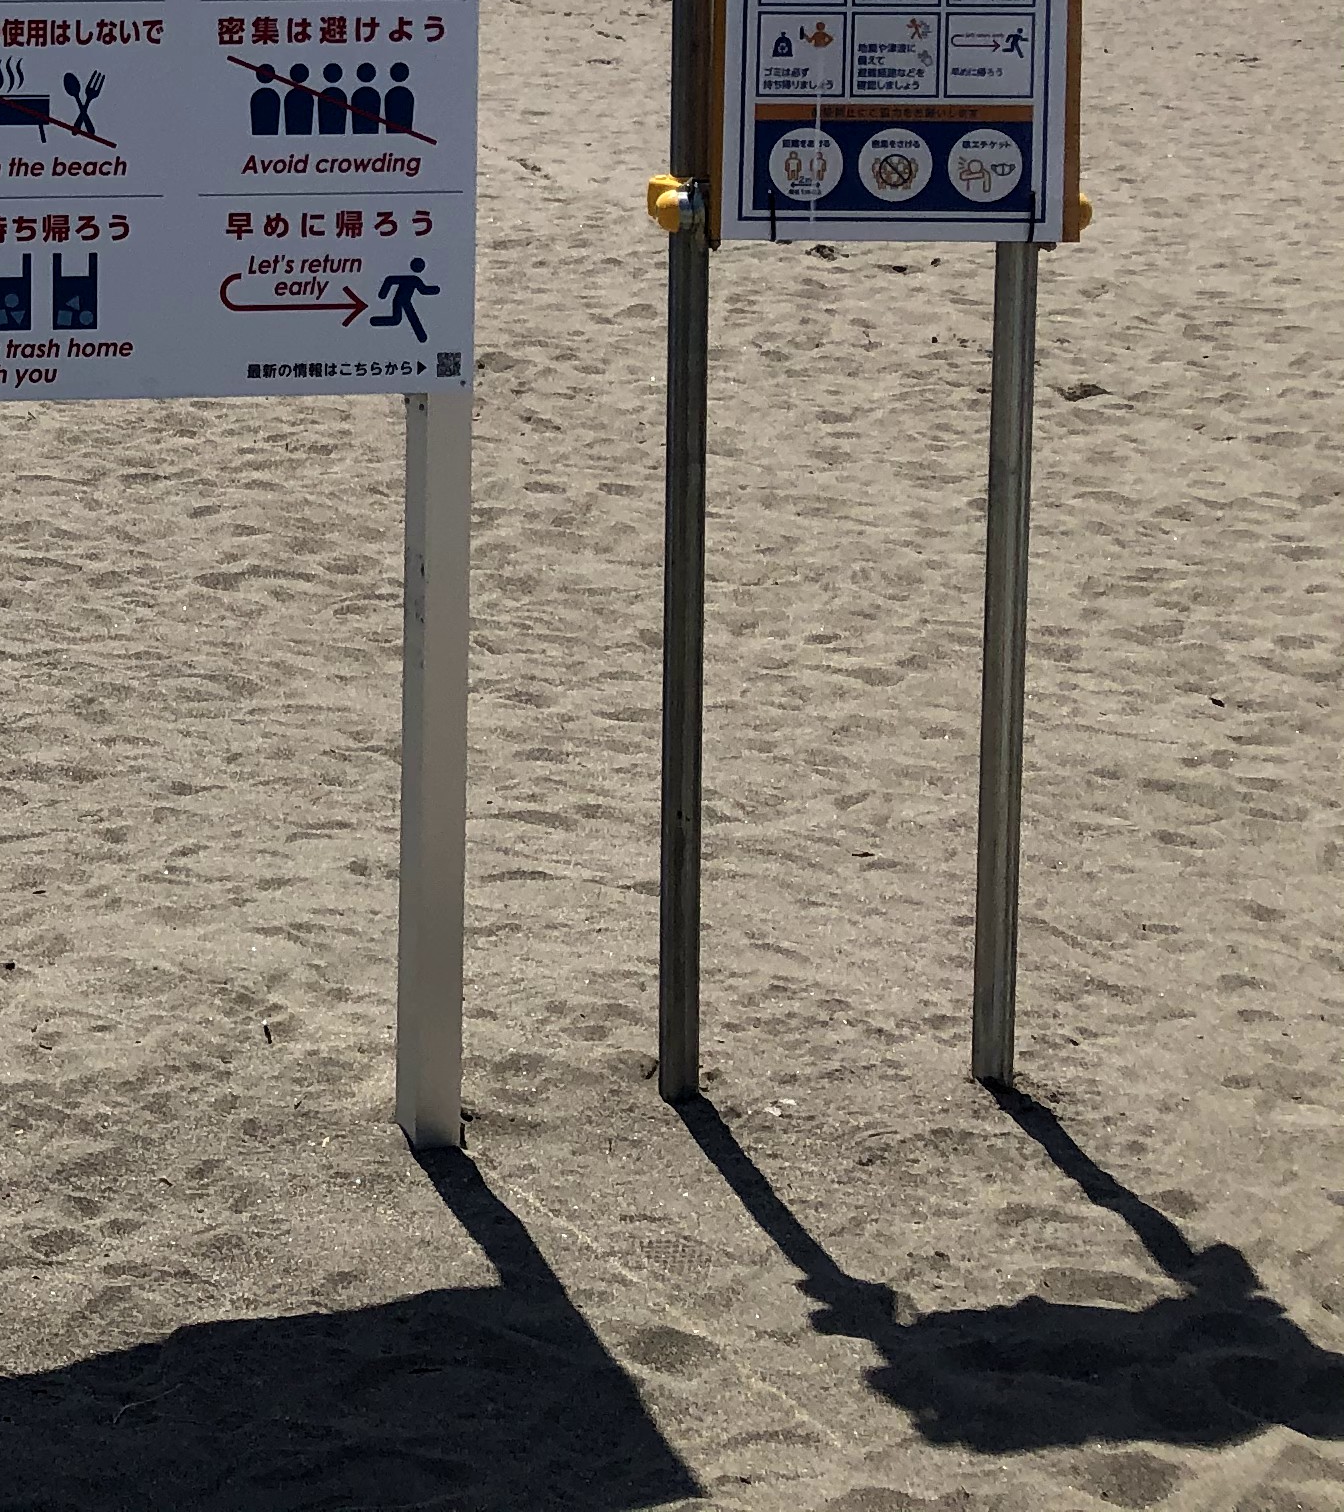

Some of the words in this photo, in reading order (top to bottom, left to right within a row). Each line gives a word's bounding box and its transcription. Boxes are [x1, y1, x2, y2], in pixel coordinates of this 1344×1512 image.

[217, 15, 447, 46] 密集は避けよう
[8, 158, 45, 178] the
[51, 156, 128, 177] beach
[241, 154, 309, 176] Avoid
[315, 155, 422, 178] crowding
[224, 209, 435, 241] 早めに帰ろう
[247, 255, 296, 276] Let's
[300, 255, 363, 275] return
[273, 276, 330, 298] early
[5, 339, 61, 360] trash
[67, 337, 135, 359] home
[14, 365, 58, 389] you
[246, 361, 413, 379] 最新の情報はこちらから
